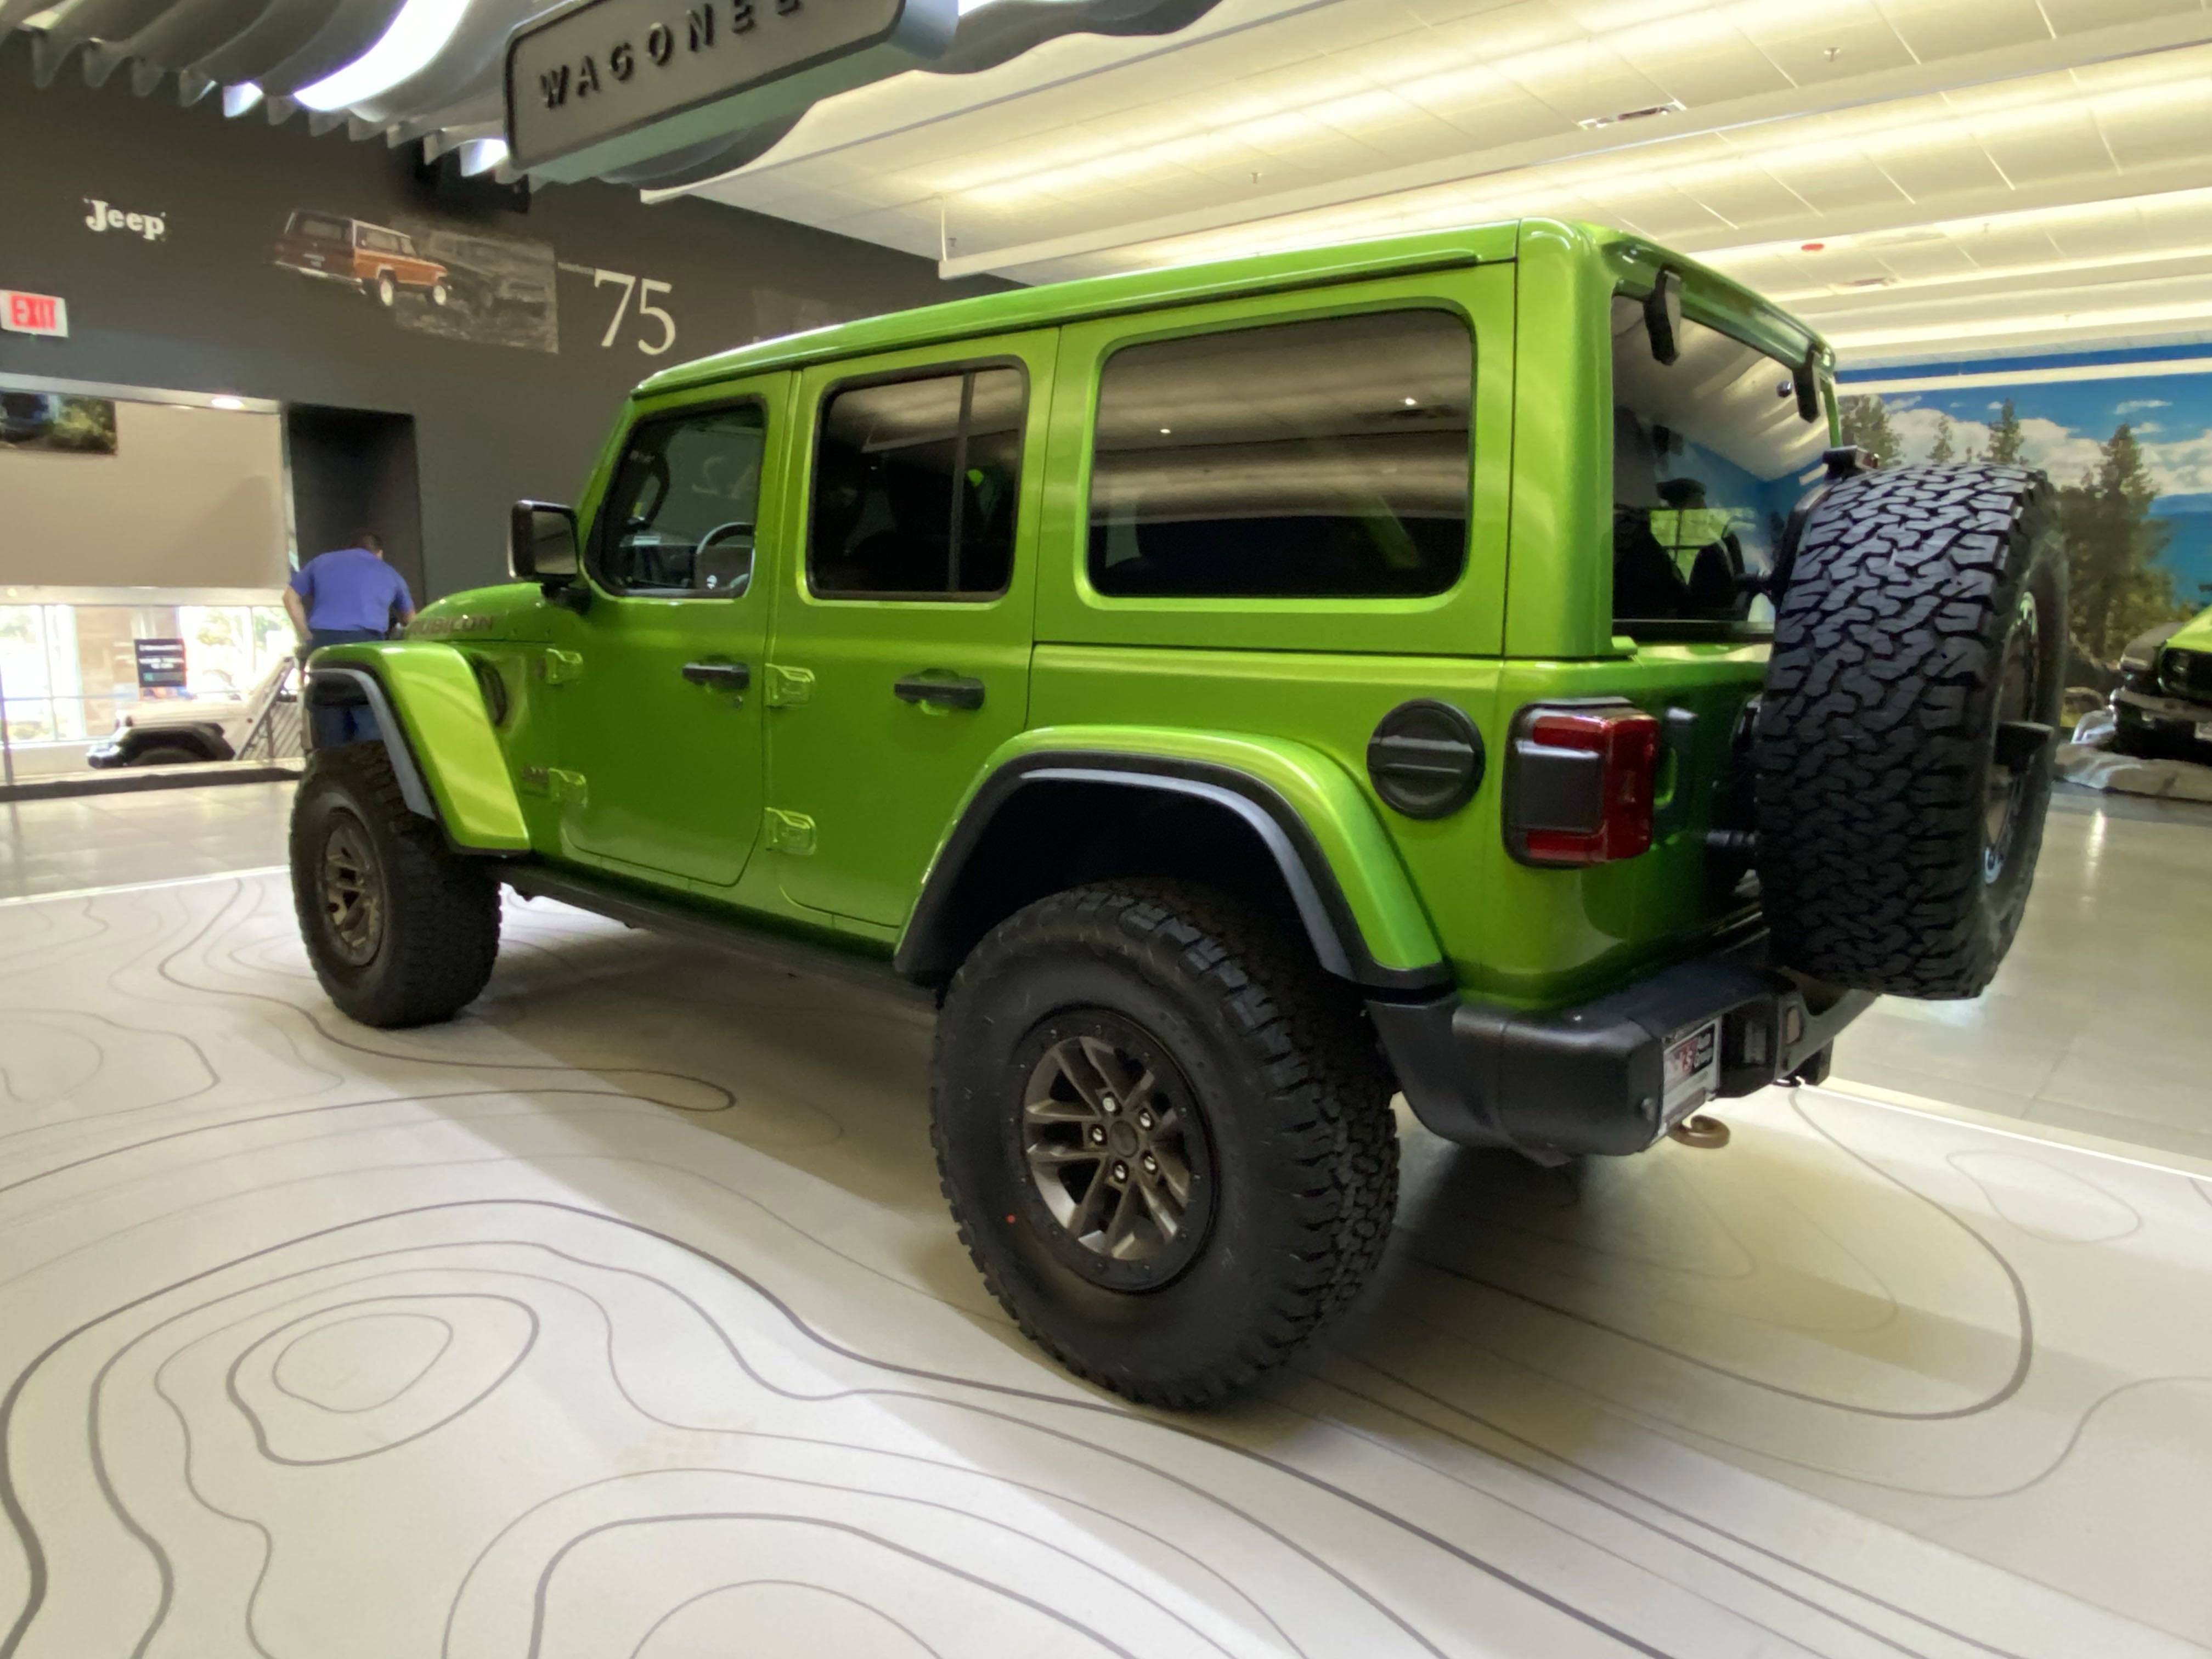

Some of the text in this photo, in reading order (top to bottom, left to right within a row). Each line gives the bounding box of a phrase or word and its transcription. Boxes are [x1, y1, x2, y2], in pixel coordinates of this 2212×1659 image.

[84, 199, 165, 240] Jeep
[9, 295, 56, 330] EXIT
[594, 268, 676, 356] 75
